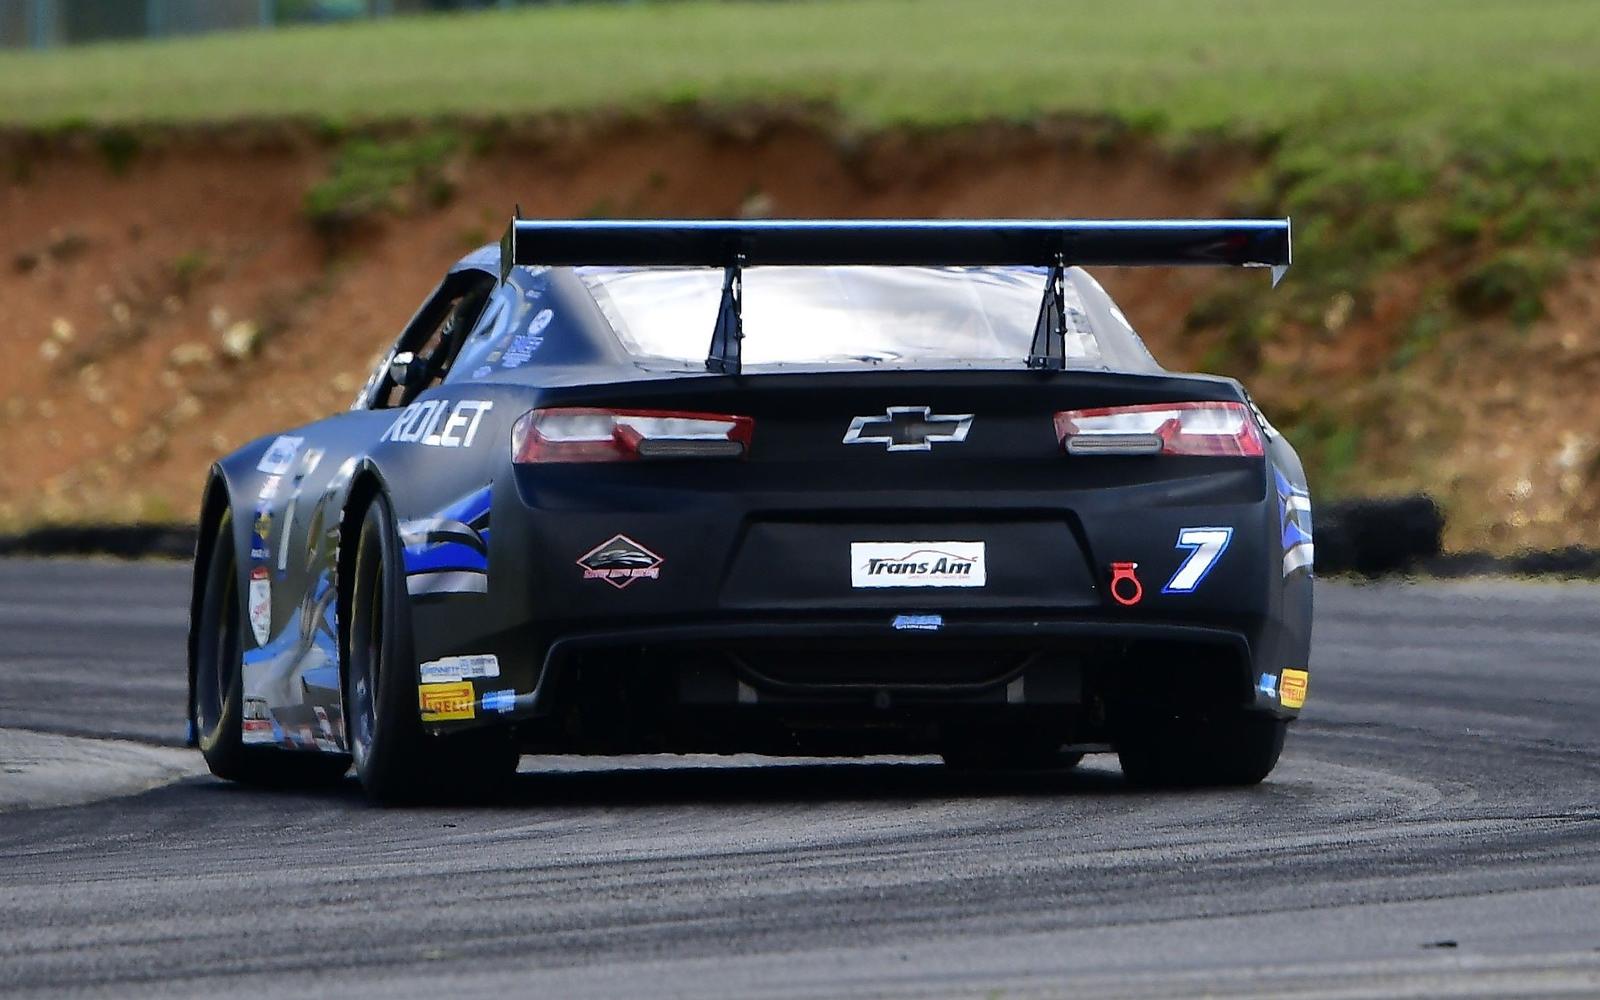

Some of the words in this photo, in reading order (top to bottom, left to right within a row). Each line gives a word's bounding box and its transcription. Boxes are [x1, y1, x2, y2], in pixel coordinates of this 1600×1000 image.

[868, 558, 929, 575] Trans
[930, 557, 972, 575] Am
[1162, 527, 1233, 593] 7
